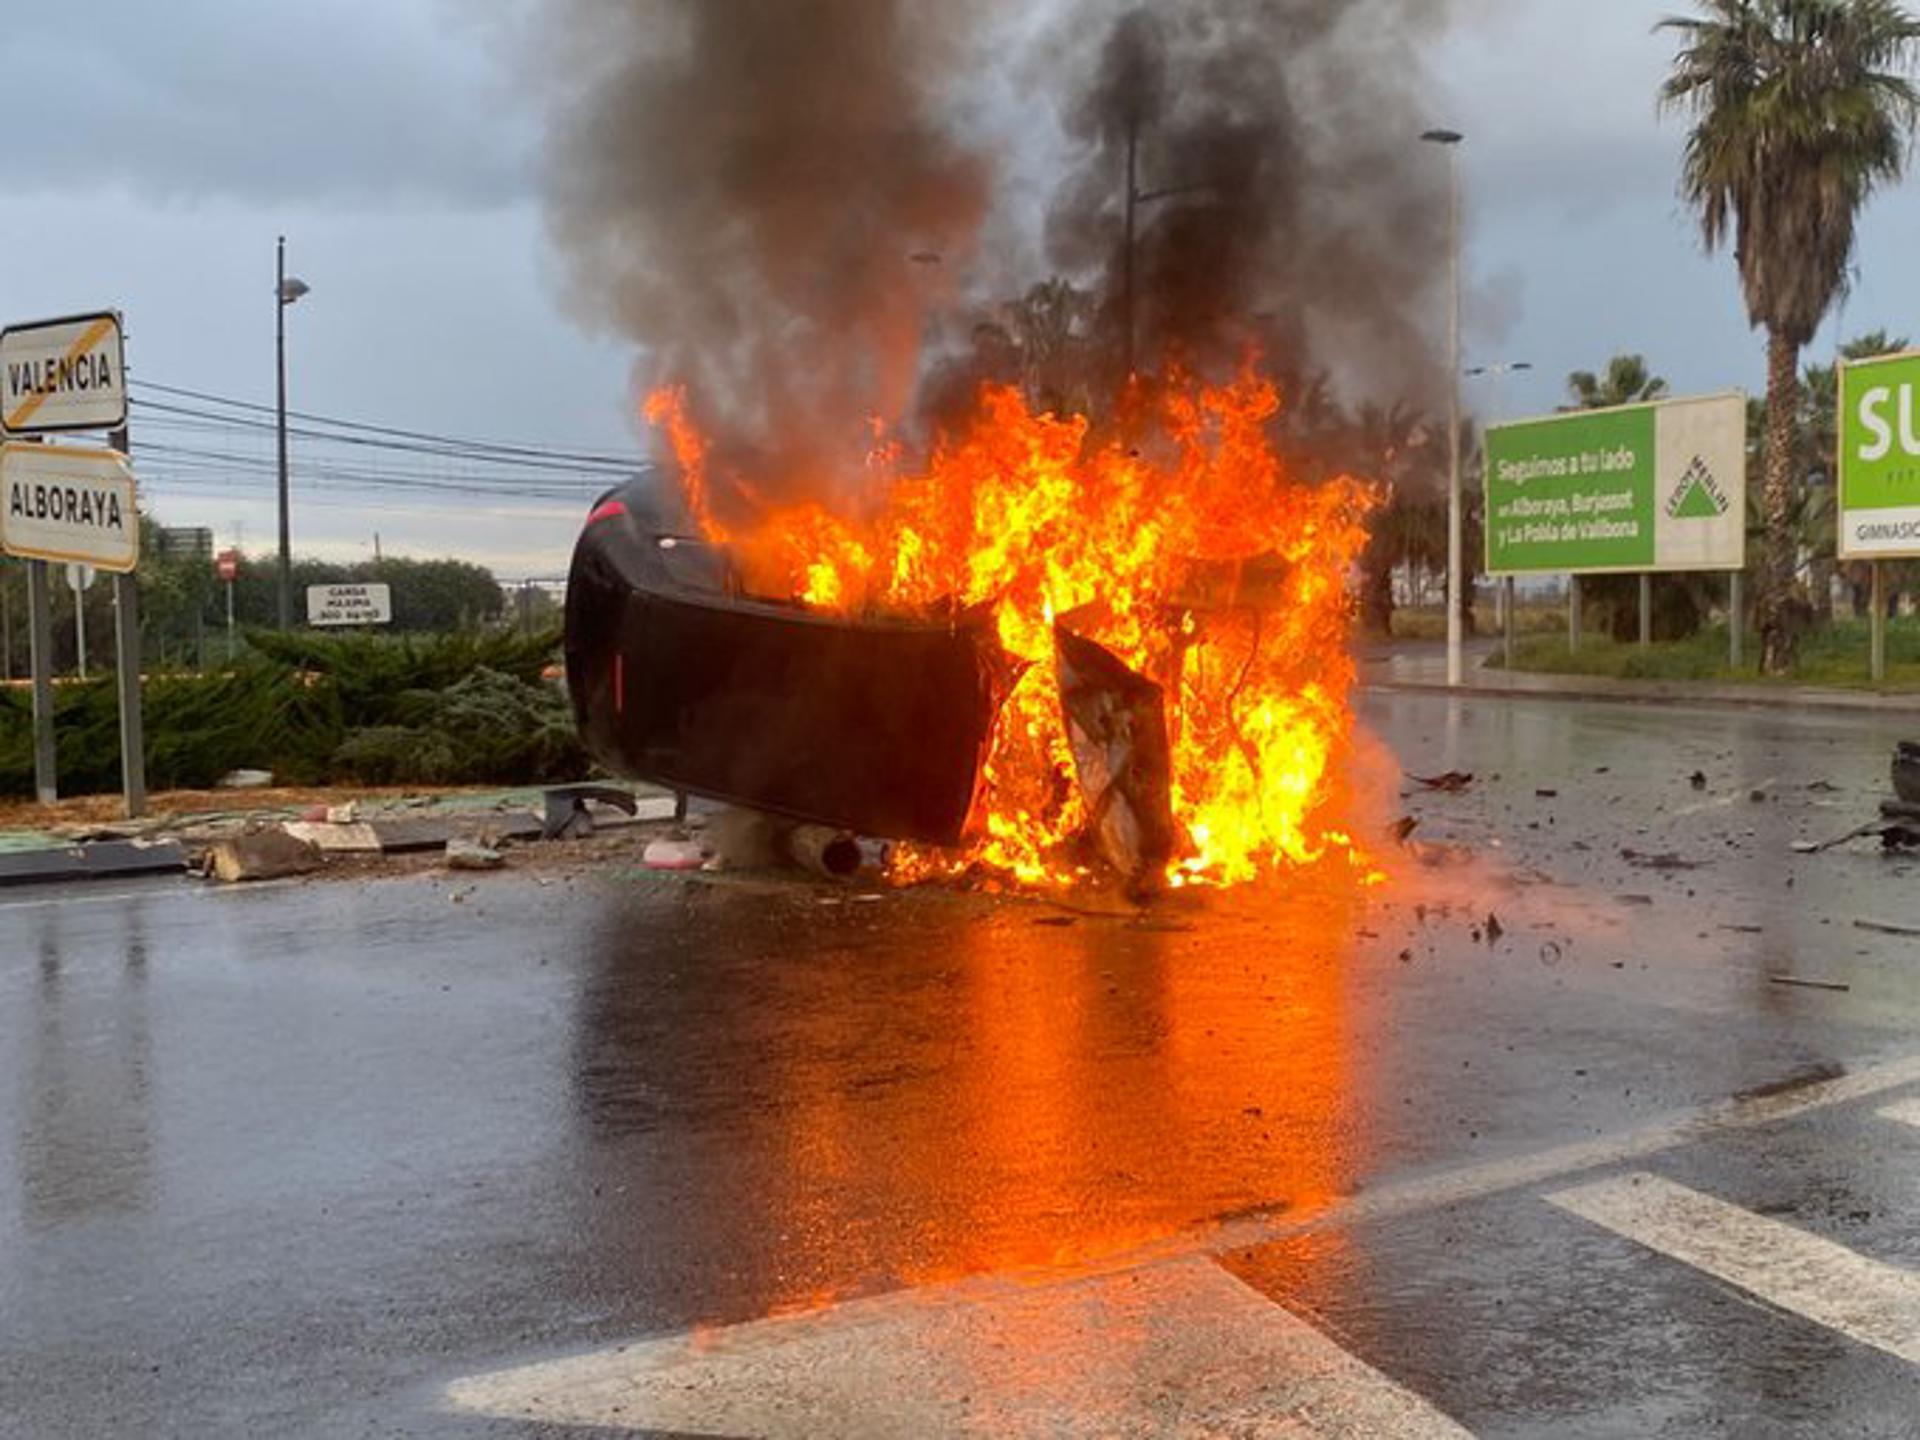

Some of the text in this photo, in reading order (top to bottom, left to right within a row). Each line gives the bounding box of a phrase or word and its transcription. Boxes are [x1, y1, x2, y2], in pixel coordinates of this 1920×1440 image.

[8, 353, 112, 396] VALENCIA
[1498, 444, 1635, 486] Seguimos a tu lado
[11, 482, 122, 529] ALBORAYA
[1499, 531, 1505, 548] y
[1507, 527, 1522, 543] La
[1524, 522, 1559, 542] Pobla
[1561, 522, 1576, 540] de
